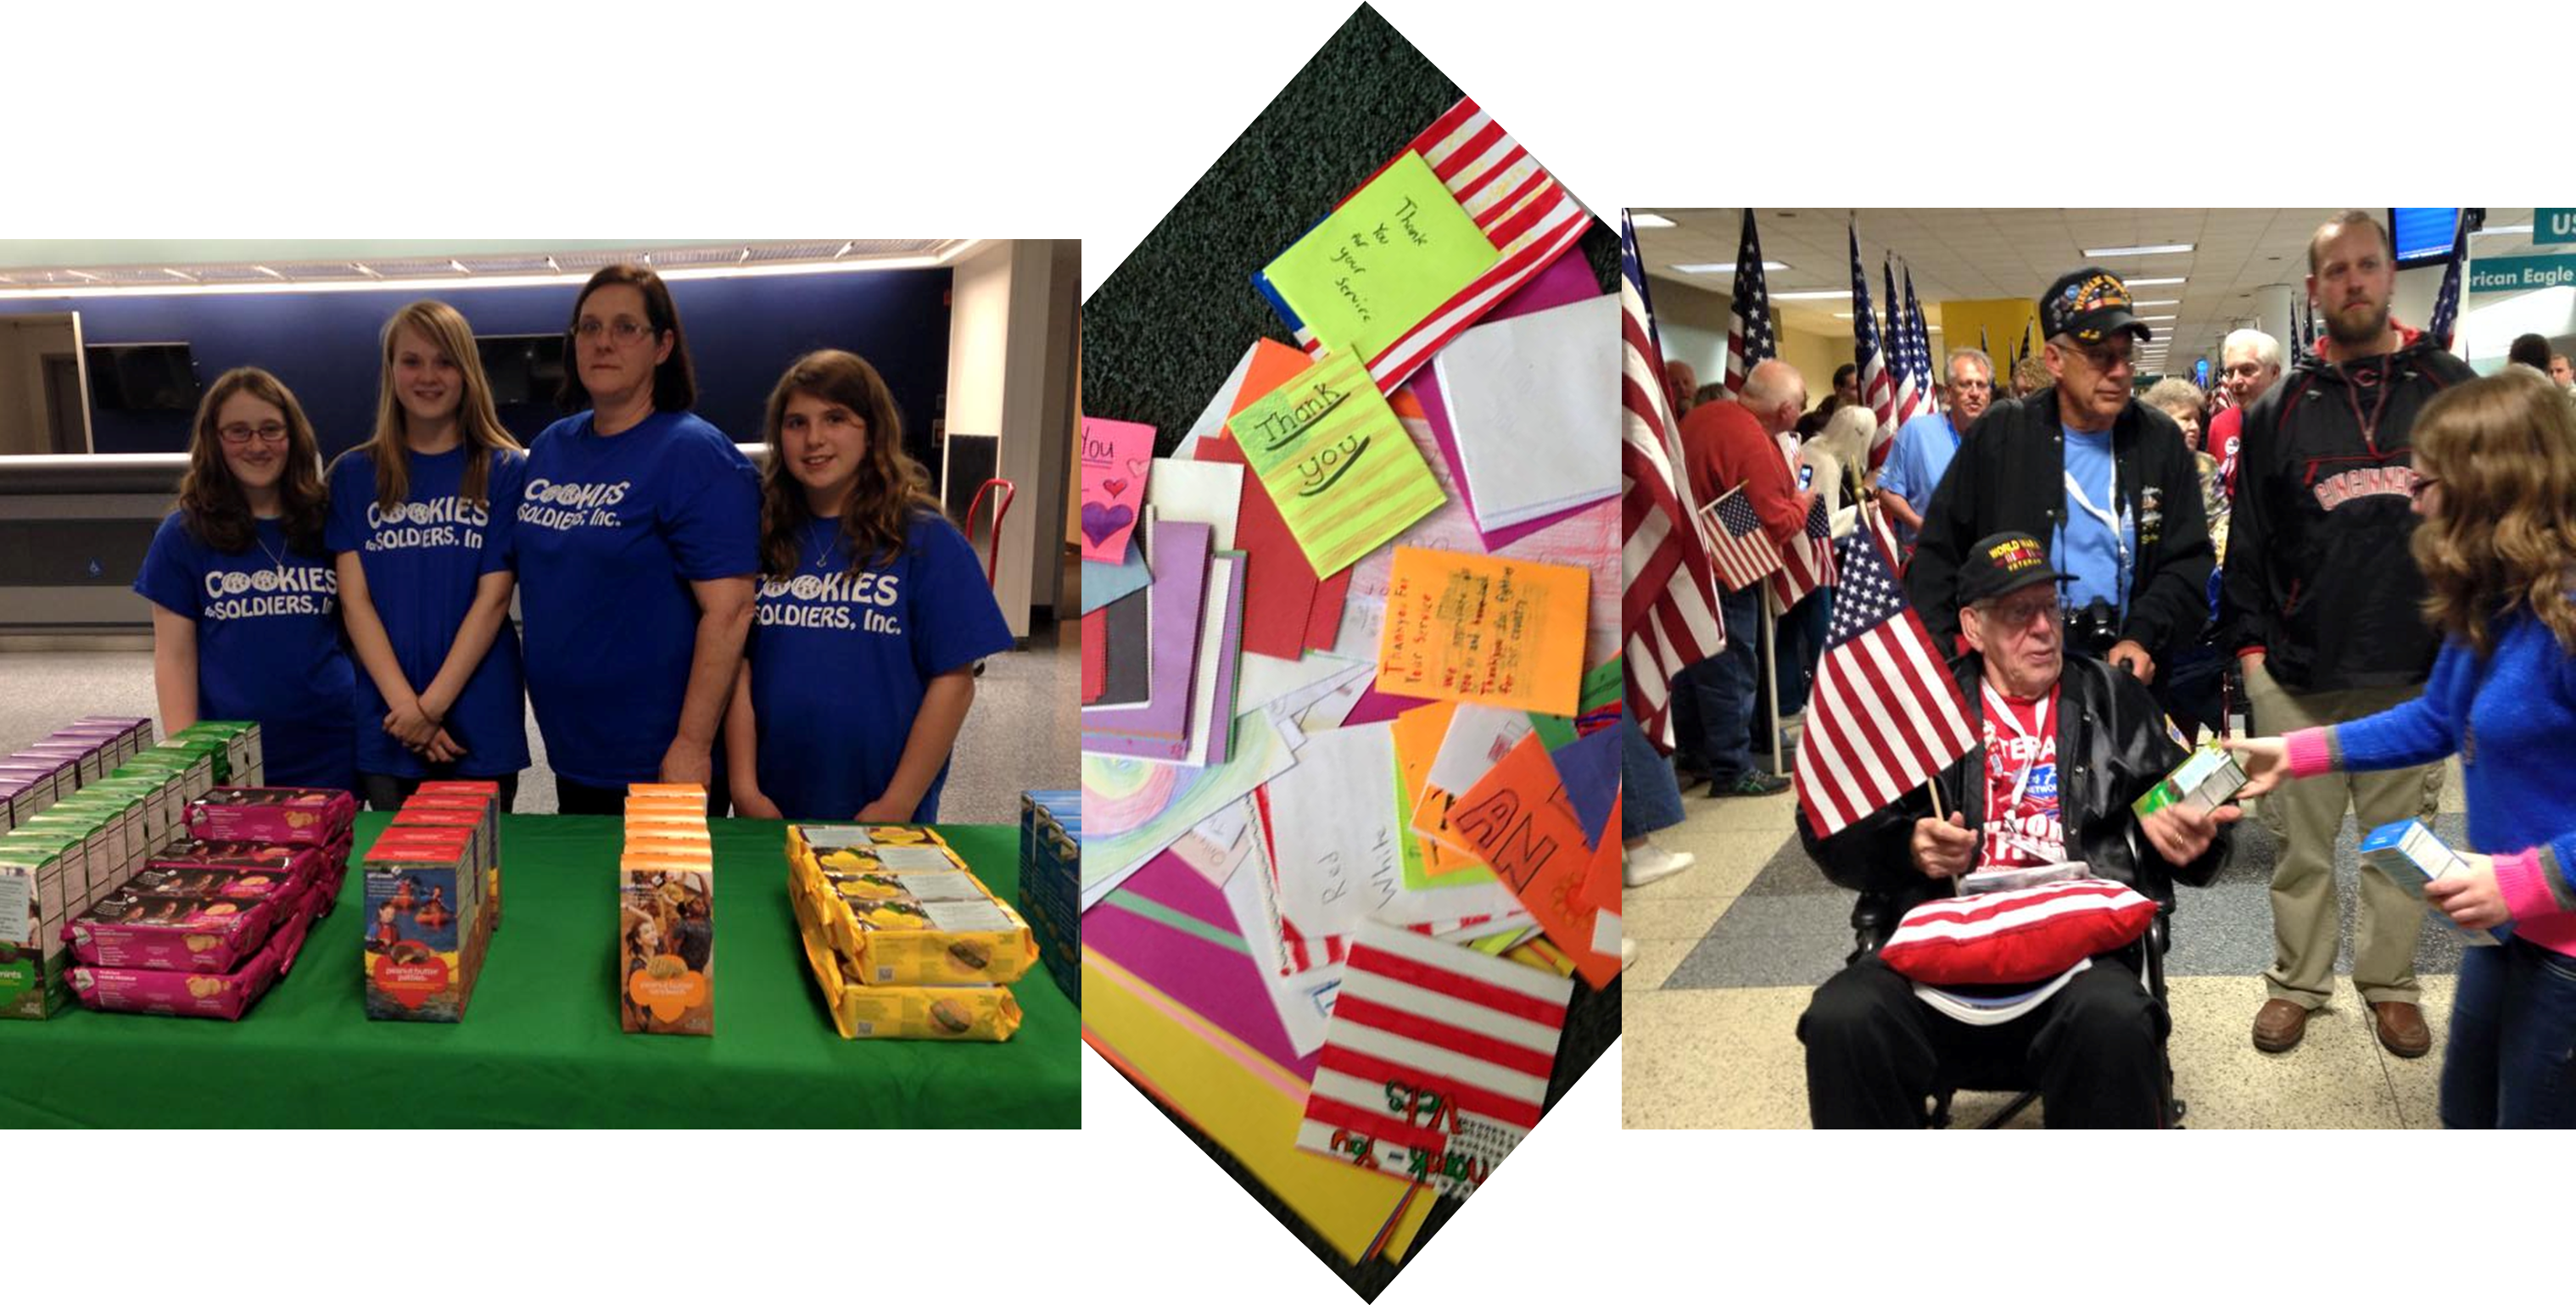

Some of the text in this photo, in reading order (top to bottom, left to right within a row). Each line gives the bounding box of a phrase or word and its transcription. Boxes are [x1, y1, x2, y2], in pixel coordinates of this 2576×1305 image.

[1372, 222, 1389, 245] You
[1395, 196, 1428, 247] Thank
[1329, 246, 1366, 274] your
[2469, 265, 2574, 287] rican Eagle
[1254, 382, 1341, 443] Thank
[1297, 434, 1358, 487] you
[367, 496, 490, 530] COOKIES
[590, 507, 622, 527] Inc.
[375, 526, 460, 552] SOLDERS,
[464, 529, 483, 549] In
[1987, 539, 2020, 559] WORLD
[204, 566, 338, 599] COOKIES
[214, 594, 319, 621] SOLDIERS,
[863, 608, 902, 635] Inc.
[1317, 850, 1347, 906] Red
